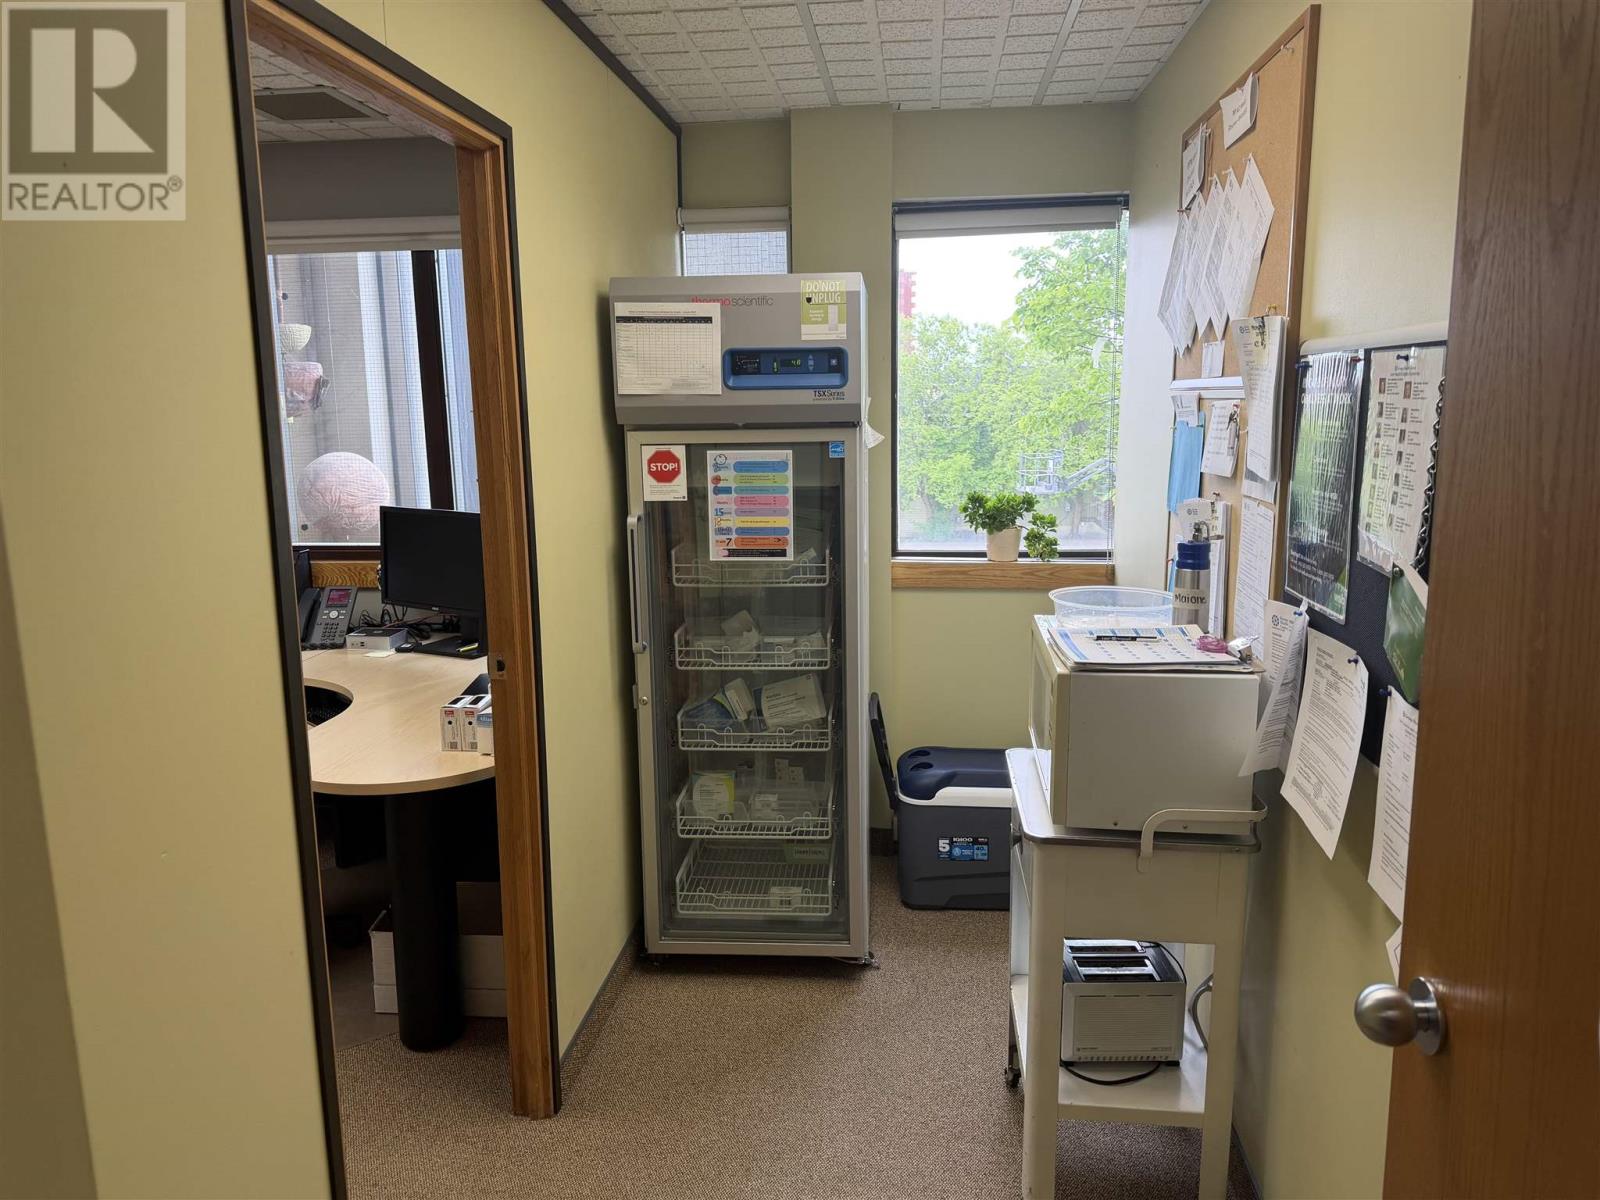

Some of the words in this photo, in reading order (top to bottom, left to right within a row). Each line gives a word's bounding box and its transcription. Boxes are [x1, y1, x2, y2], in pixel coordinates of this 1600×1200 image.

[806, 281, 819, 292] DO
[821, 281, 841, 292] NOT
[731, 295, 774, 307] scientific
[813, 390, 827, 398] TSX
[650, 462, 678, 472] STOP!
[726, 537, 733, 547] 7
[938, 839, 950, 852] 5
